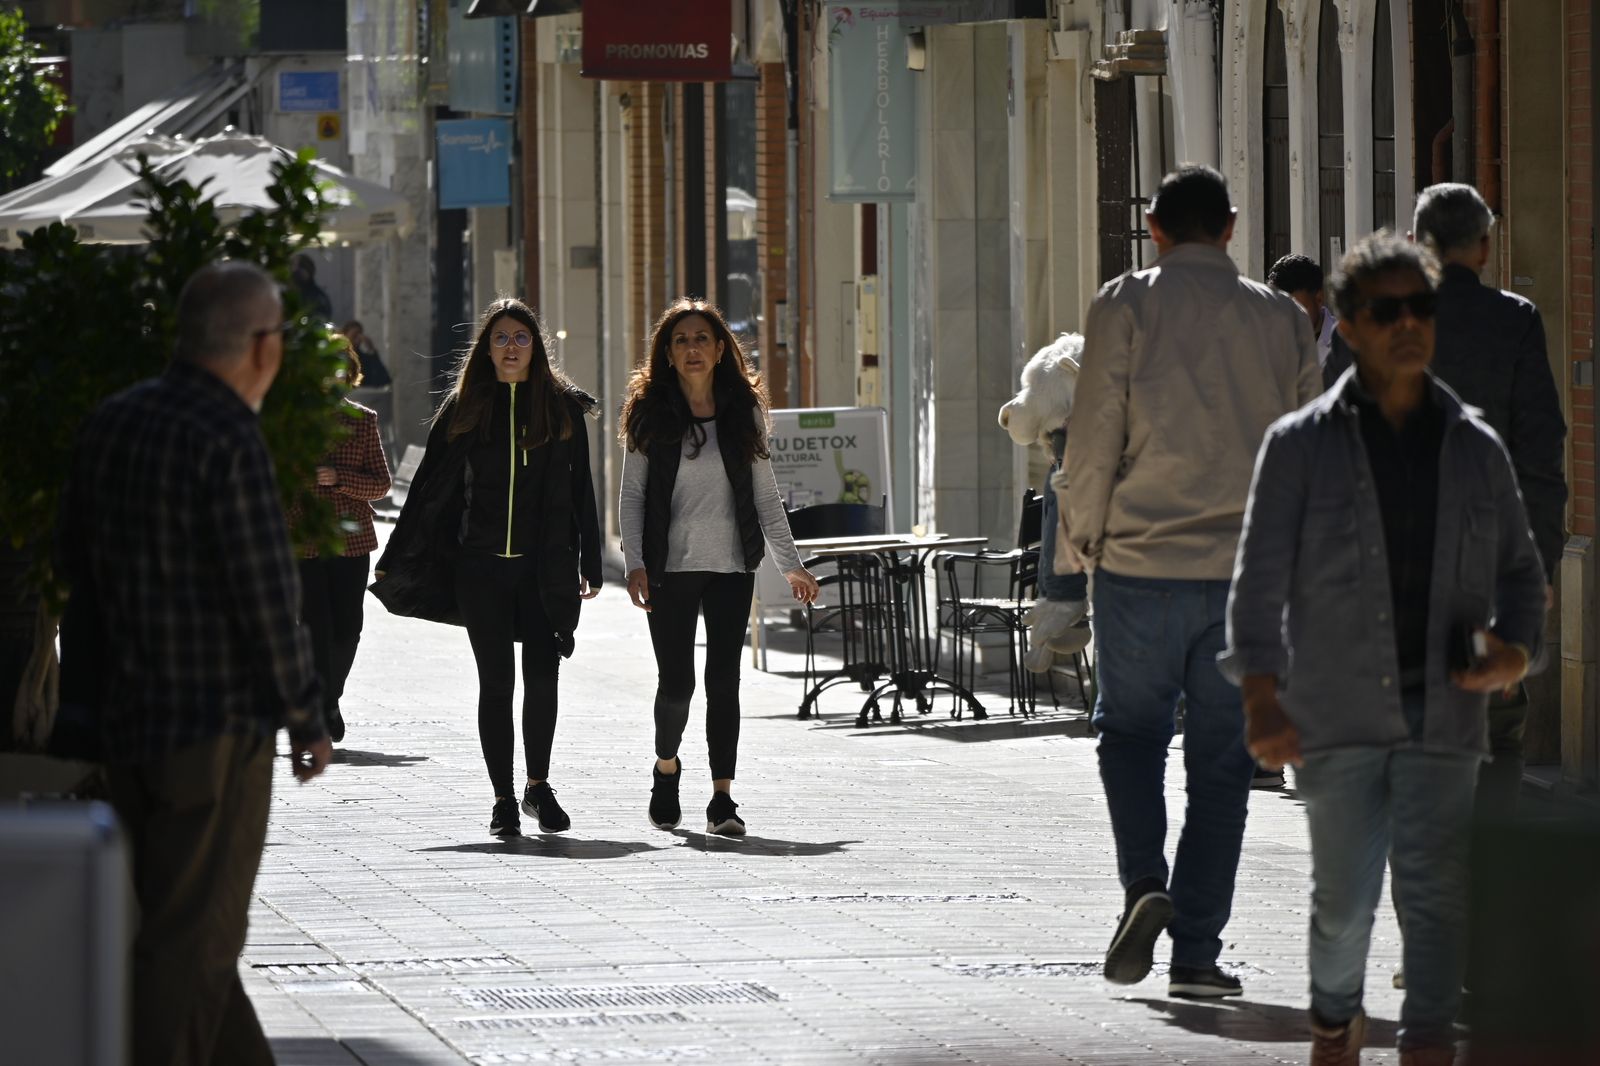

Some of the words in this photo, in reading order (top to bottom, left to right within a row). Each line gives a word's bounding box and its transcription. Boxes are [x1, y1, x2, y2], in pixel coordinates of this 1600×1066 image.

[605, 43, 709, 59] PRONOVIAS
[877, 25, 890, 192] HERBOLARIO
[793, 435, 857, 451] DETOX
